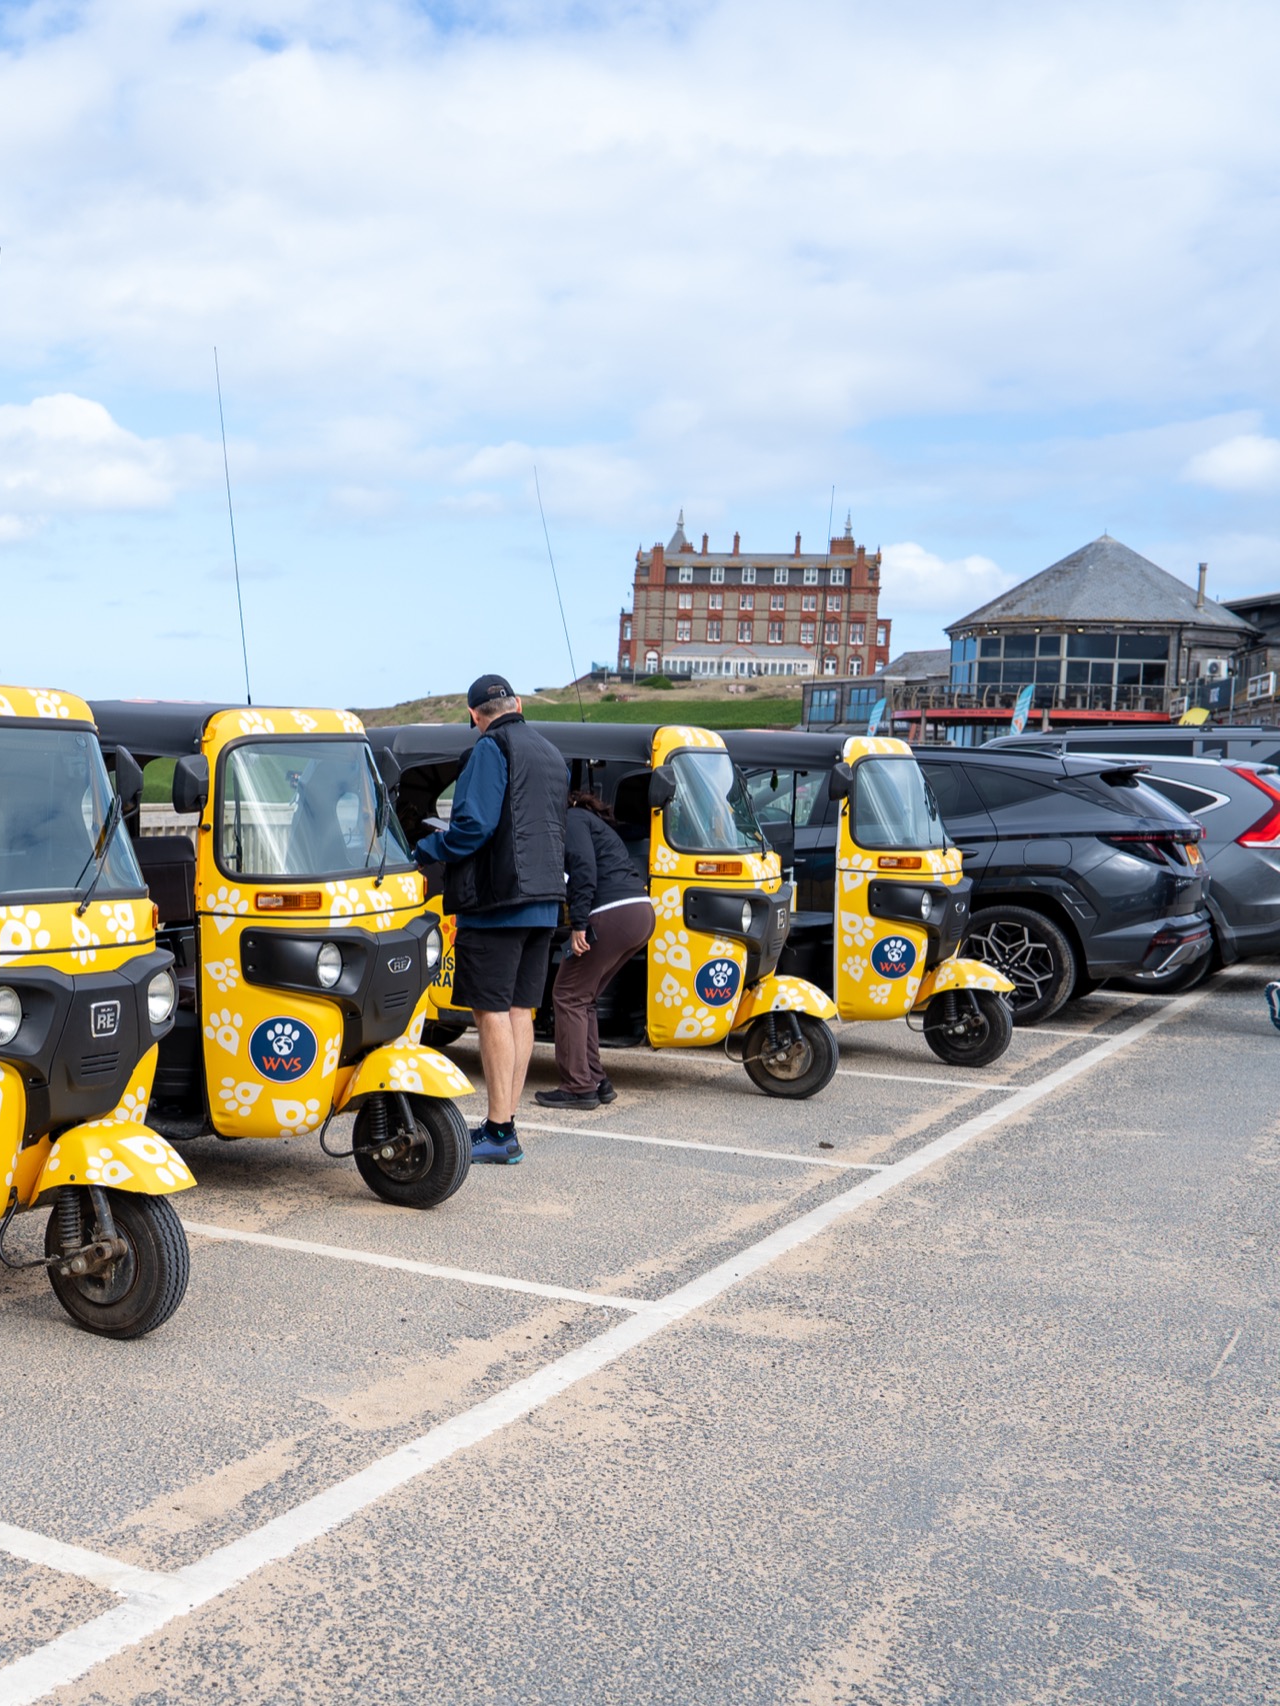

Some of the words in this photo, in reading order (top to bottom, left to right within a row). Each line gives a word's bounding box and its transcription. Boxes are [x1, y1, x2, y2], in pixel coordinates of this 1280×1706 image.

[880, 961, 907, 973] WVS
[704, 987, 731, 999] WVS
[97, 1012, 115, 1030] RE
[262, 1056, 302, 1072] WVS
